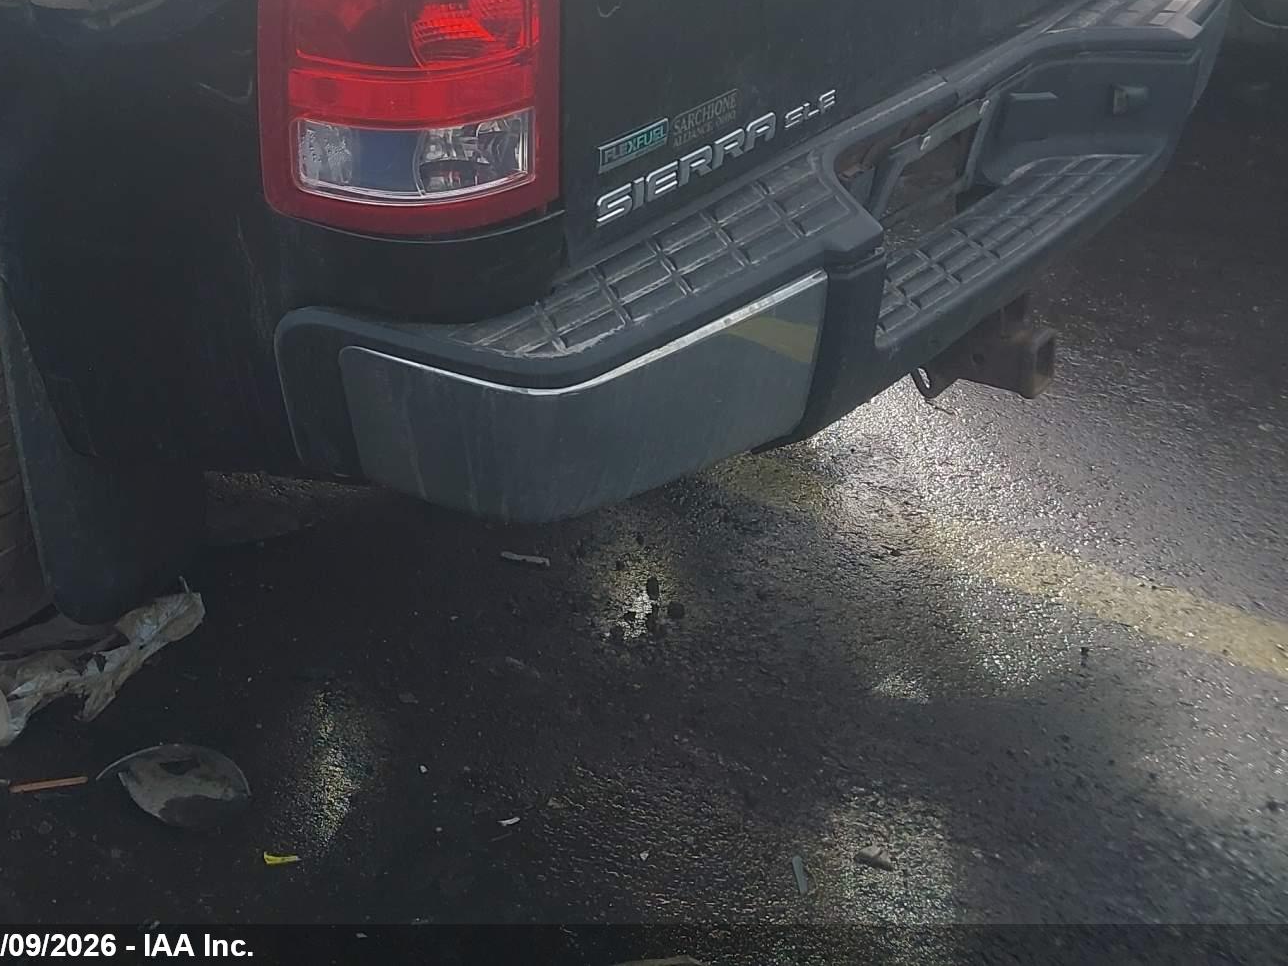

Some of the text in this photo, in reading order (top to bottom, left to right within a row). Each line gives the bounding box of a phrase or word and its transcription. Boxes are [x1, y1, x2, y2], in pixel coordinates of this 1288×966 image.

[673, 93, 738, 134] SARCHIONE
[596, 89, 836, 227] SIERRA SLE
[604, 125, 666, 164] FLEXFUEL
